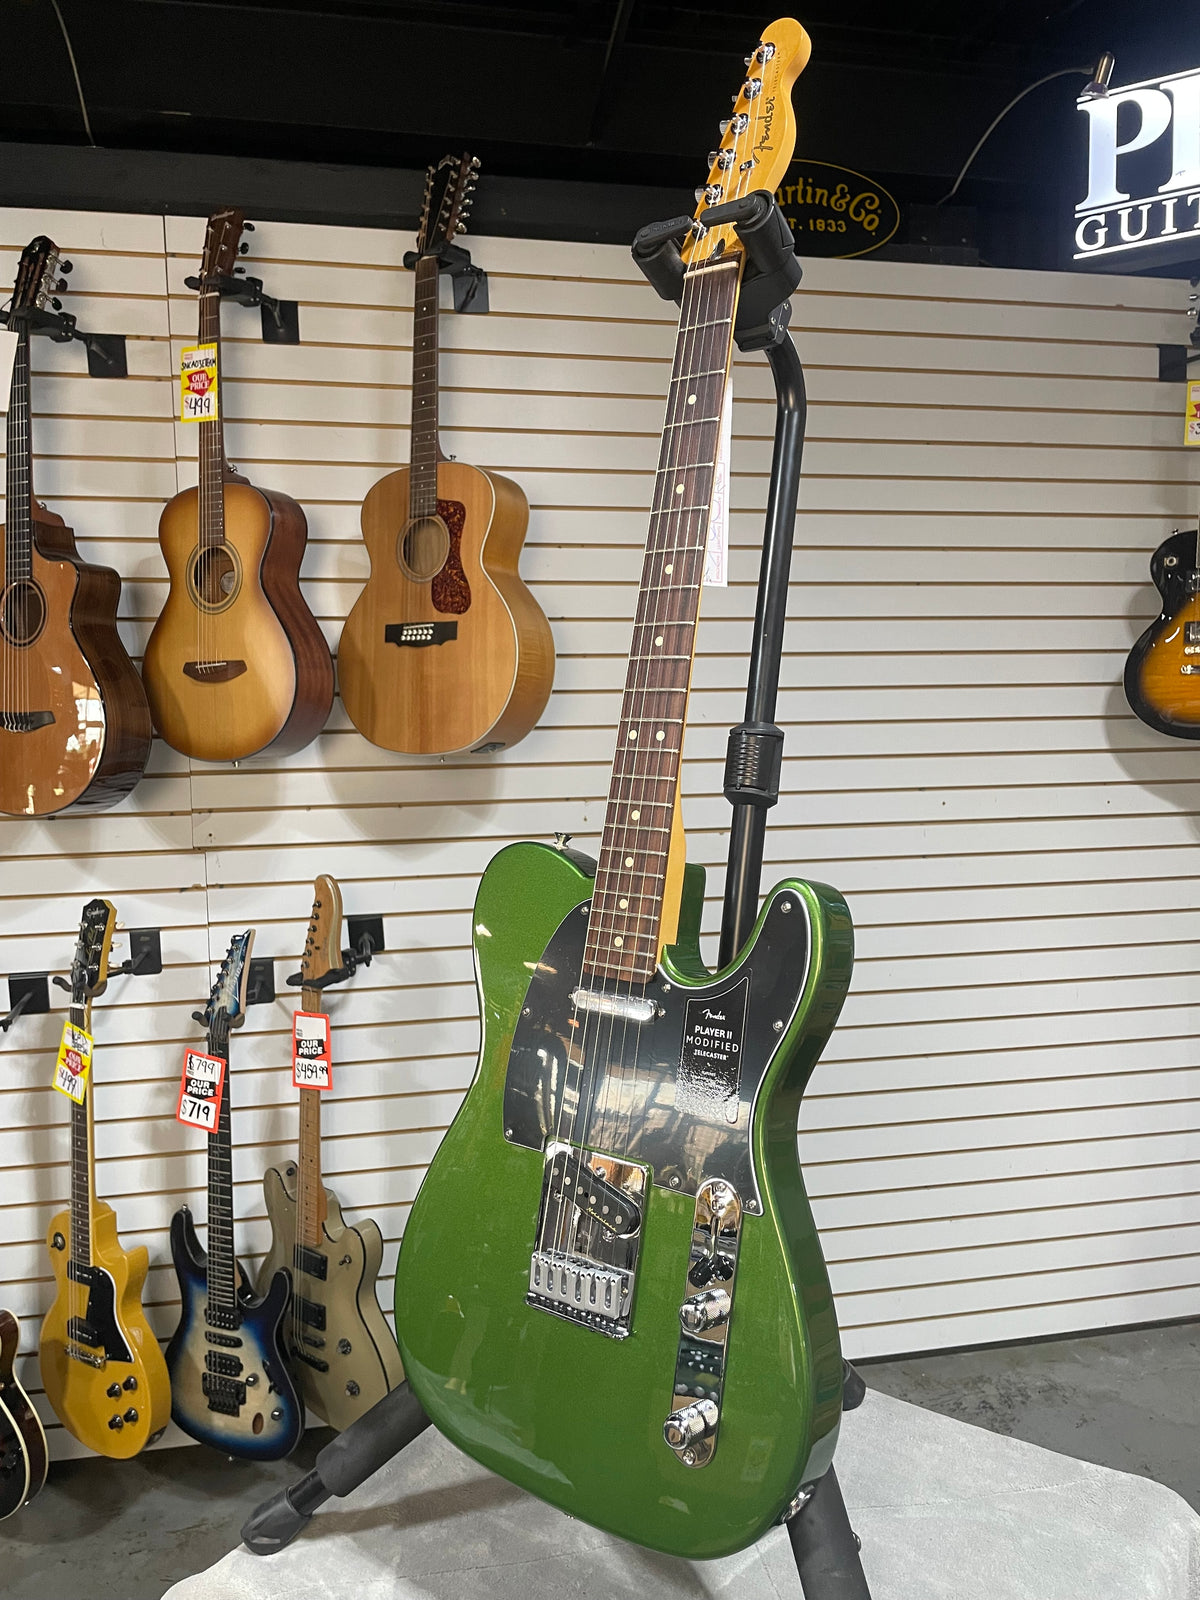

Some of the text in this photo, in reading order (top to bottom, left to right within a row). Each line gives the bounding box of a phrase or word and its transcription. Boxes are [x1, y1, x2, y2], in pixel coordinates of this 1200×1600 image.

[753, 96, 777, 164] Fender
[808, 218, 847, 233] 1833
[192, 374, 208, 383] OUR
[190, 381, 210, 391] PRICE
[184, 396, 211, 416] $499
[702, 1008, 726, 1021] Fender
[694, 1024, 725, 1039] PLAYER
[301, 1040, 319, 1049] OUR
[686, 1035, 739, 1052] MODIFIED
[298, 1046, 324, 1056] PRICE
[190, 1079, 210, 1089] OUR
[186, 1085, 215, 1097] PRICE
[181, 1099, 211, 1122] $719
